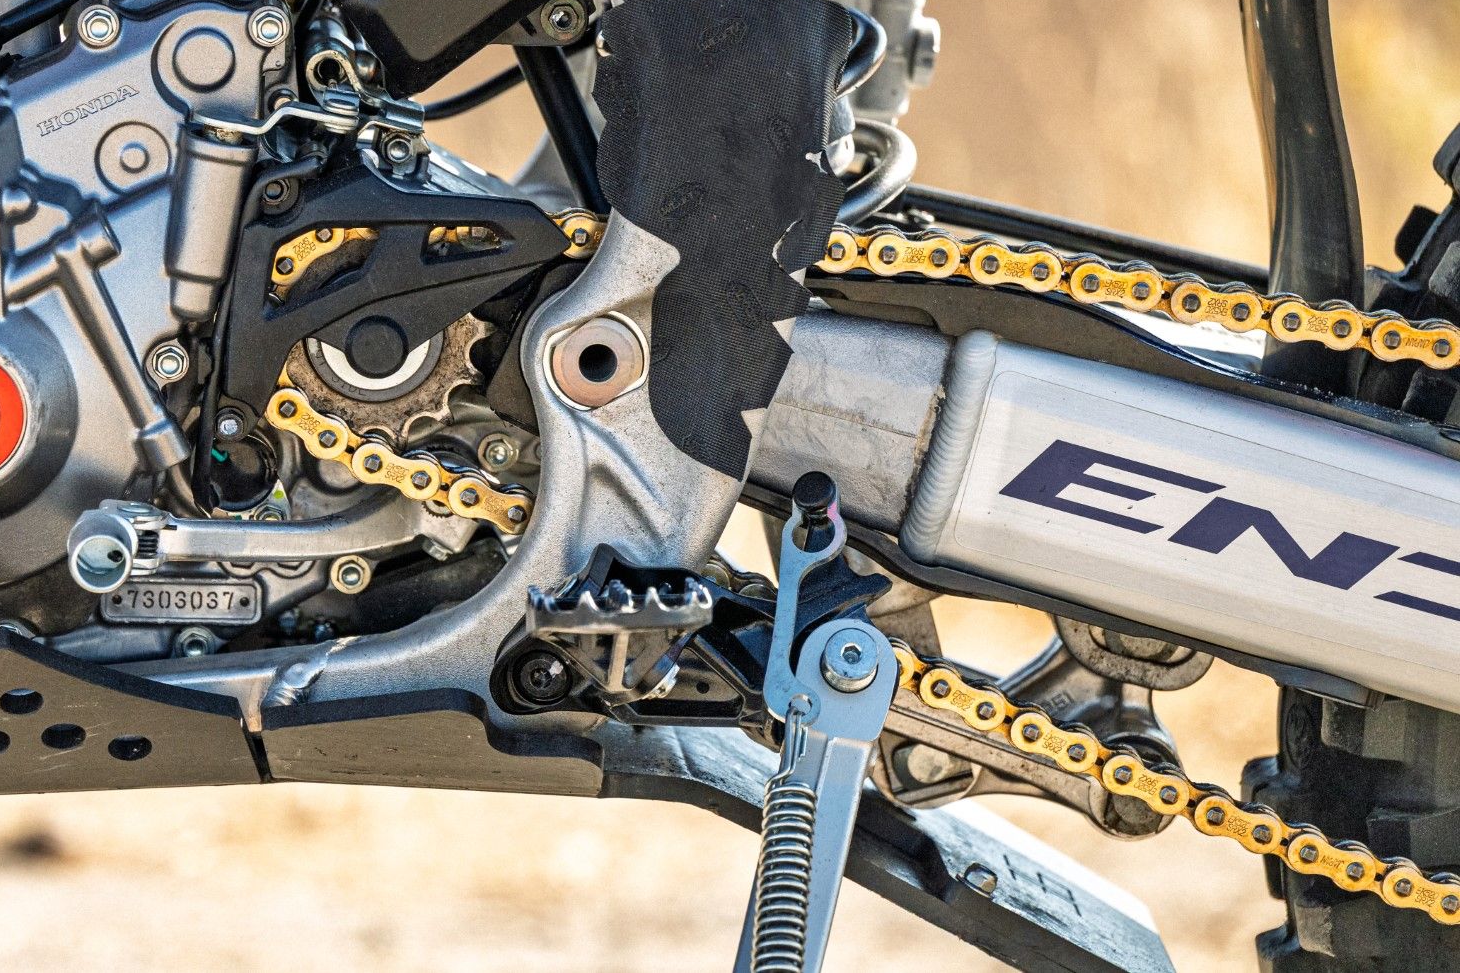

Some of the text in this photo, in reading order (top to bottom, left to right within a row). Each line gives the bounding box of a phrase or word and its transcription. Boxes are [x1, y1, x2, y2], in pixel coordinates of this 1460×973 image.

[36, 84, 140, 137] HONDA
[999, 439, 1460, 622] EN
[127, 589, 234, 610] 7303037
